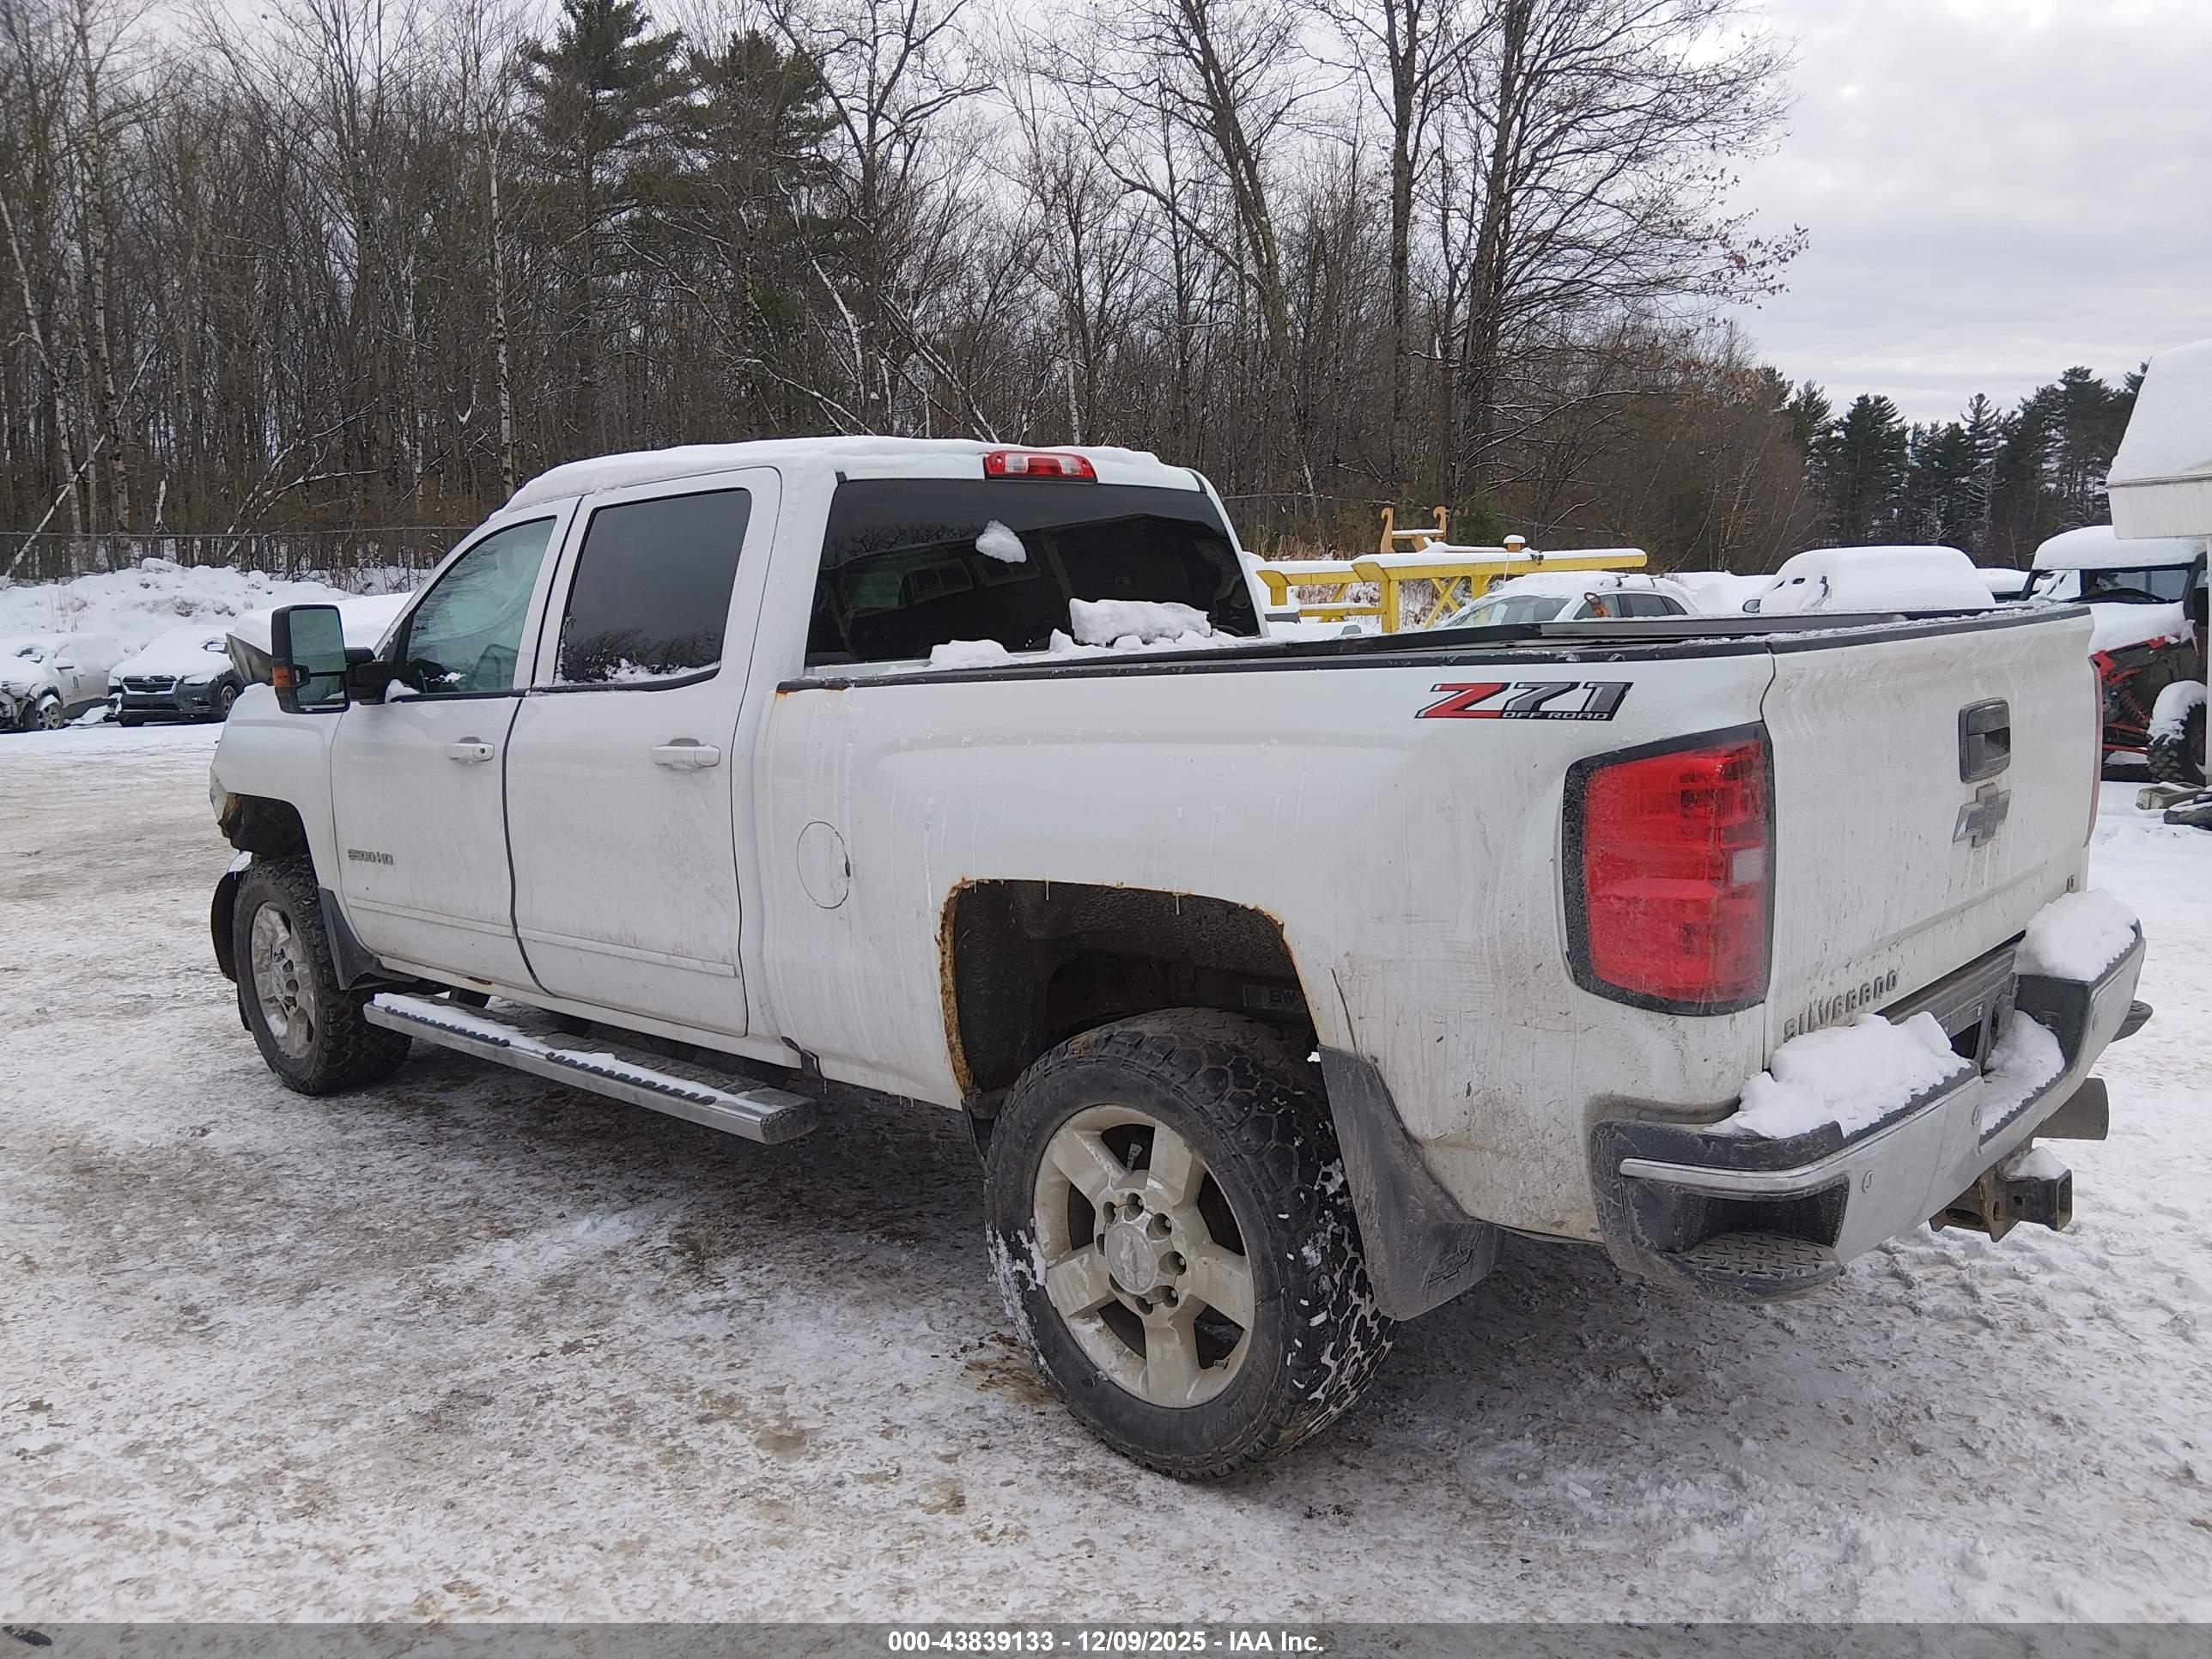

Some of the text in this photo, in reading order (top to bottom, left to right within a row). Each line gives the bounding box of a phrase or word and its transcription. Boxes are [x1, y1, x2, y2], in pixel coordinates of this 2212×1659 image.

[1415, 682, 1634, 720] Z71
[1547, 712, 1609, 720] ROAD
[1784, 969, 1899, 1043] SILVERADO
